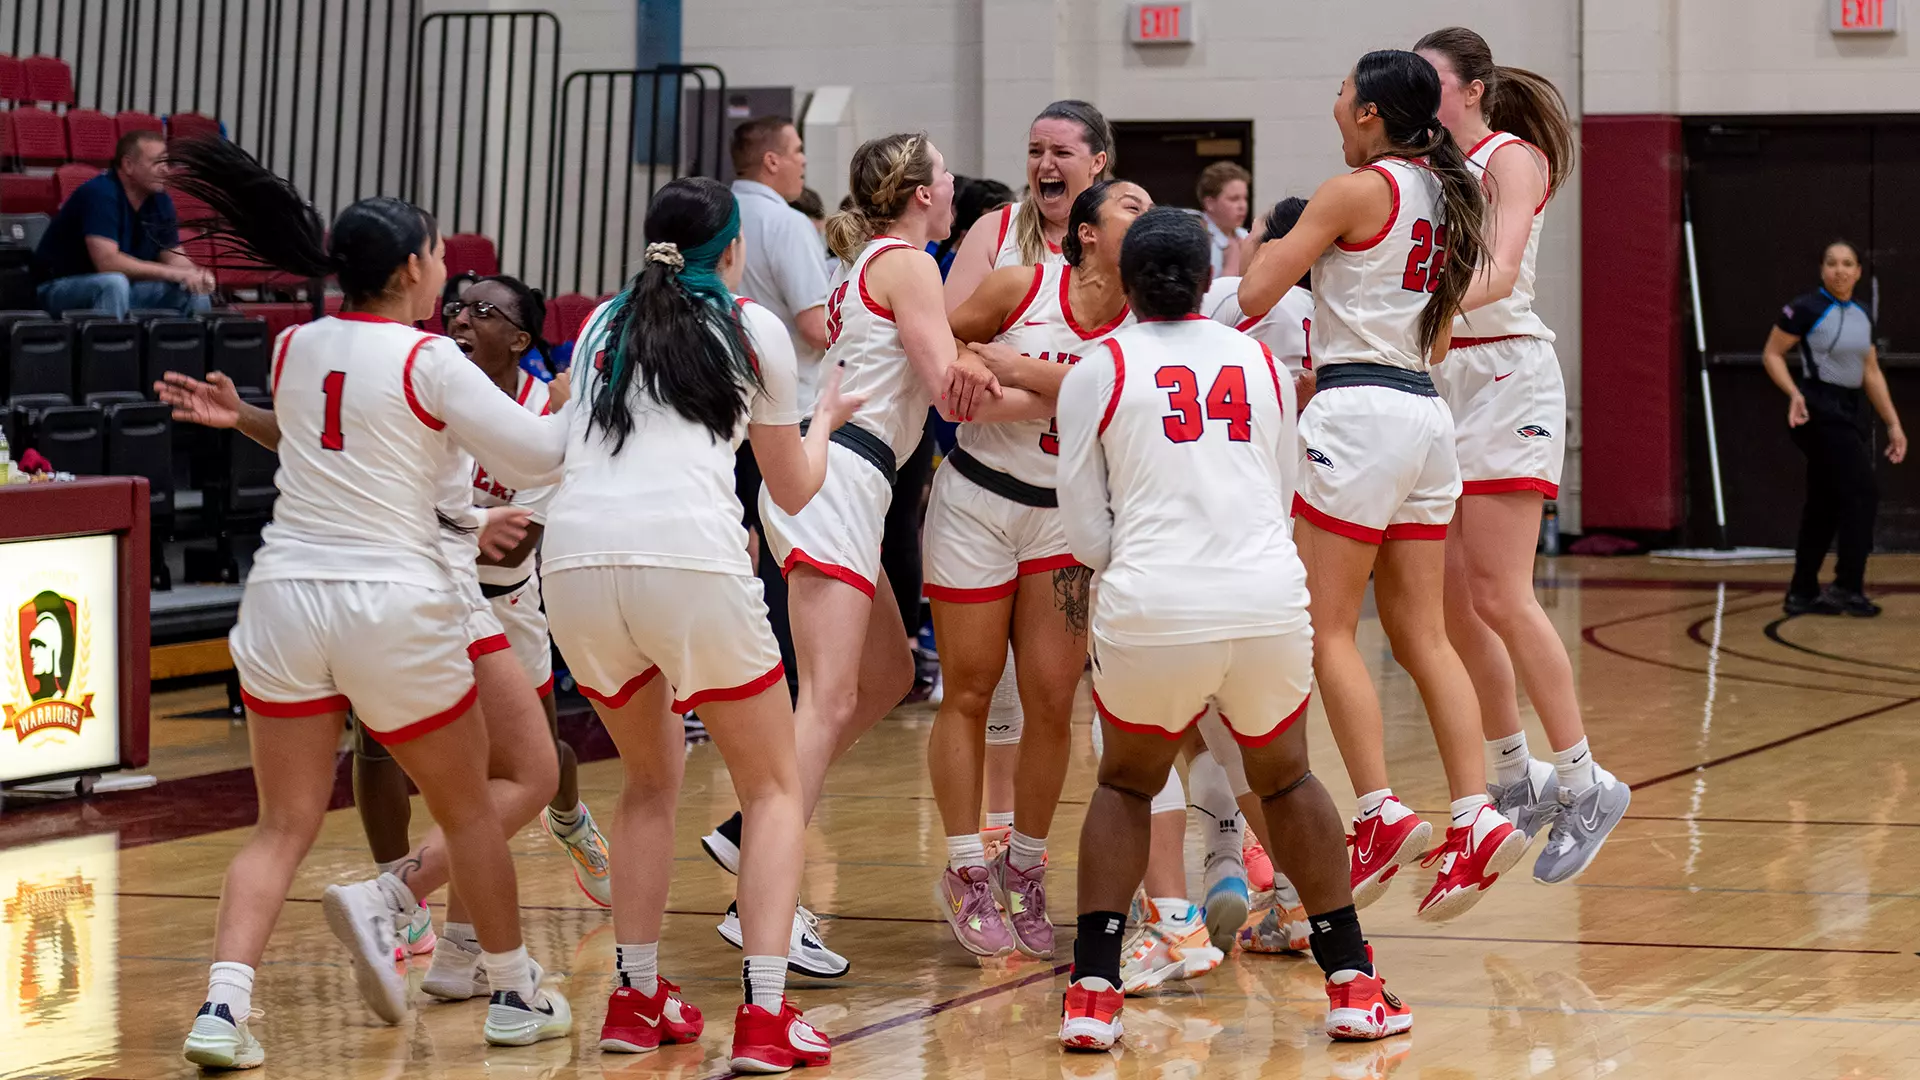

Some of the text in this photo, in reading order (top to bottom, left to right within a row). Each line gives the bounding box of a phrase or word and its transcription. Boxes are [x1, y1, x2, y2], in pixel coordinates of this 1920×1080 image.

[1141, 6, 1182, 38] EXIT
[321, 370, 346, 452] 1
[1154, 365, 1252, 444] 34
[18, 704, 79, 734] WARRIORS
